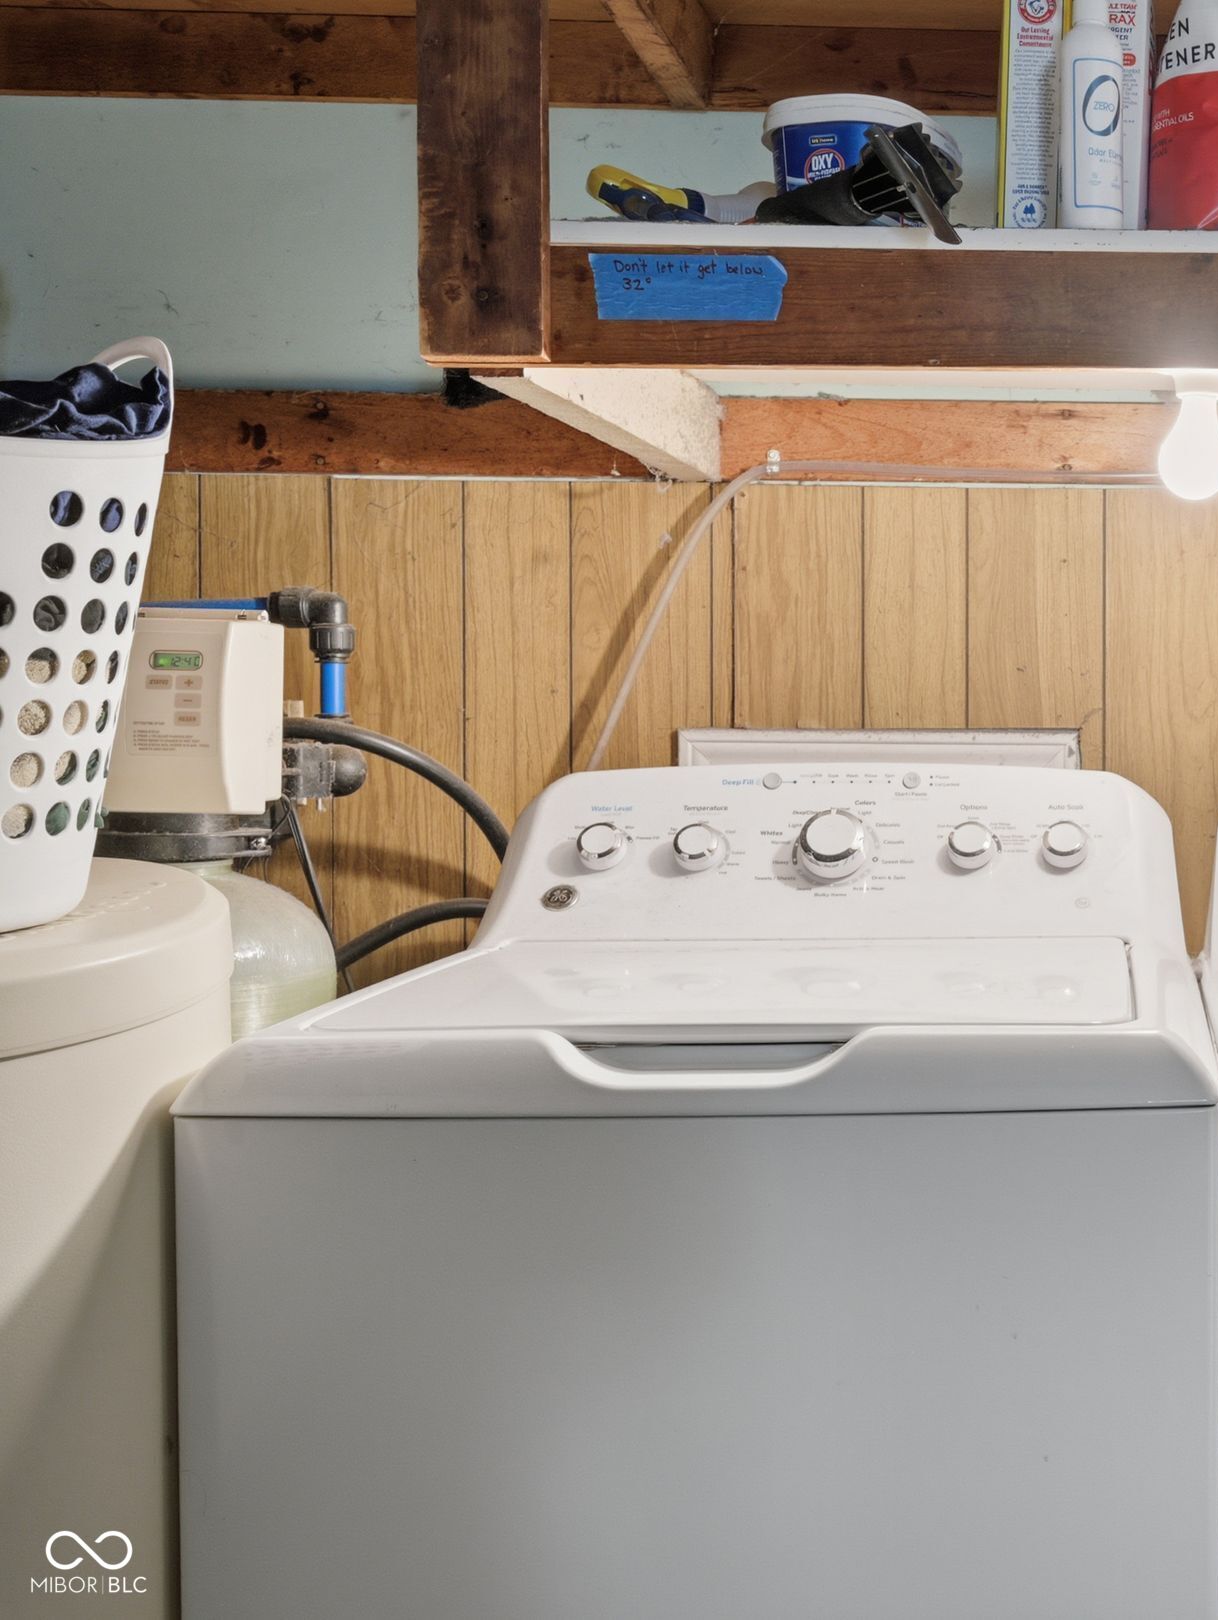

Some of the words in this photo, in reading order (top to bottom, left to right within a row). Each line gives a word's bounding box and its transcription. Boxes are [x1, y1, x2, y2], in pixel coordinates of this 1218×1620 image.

[1109, 14, 1136, 26] RAX
[1093, 102, 1116, 112] ZERO
[1178, 112, 1194, 123] OILS
[812, 153, 834, 172] OXY
[613, 259, 648, 274] Don't
[656, 261, 674, 274] let
[680, 262, 690, 274] it
[698, 260, 716, 280] get
